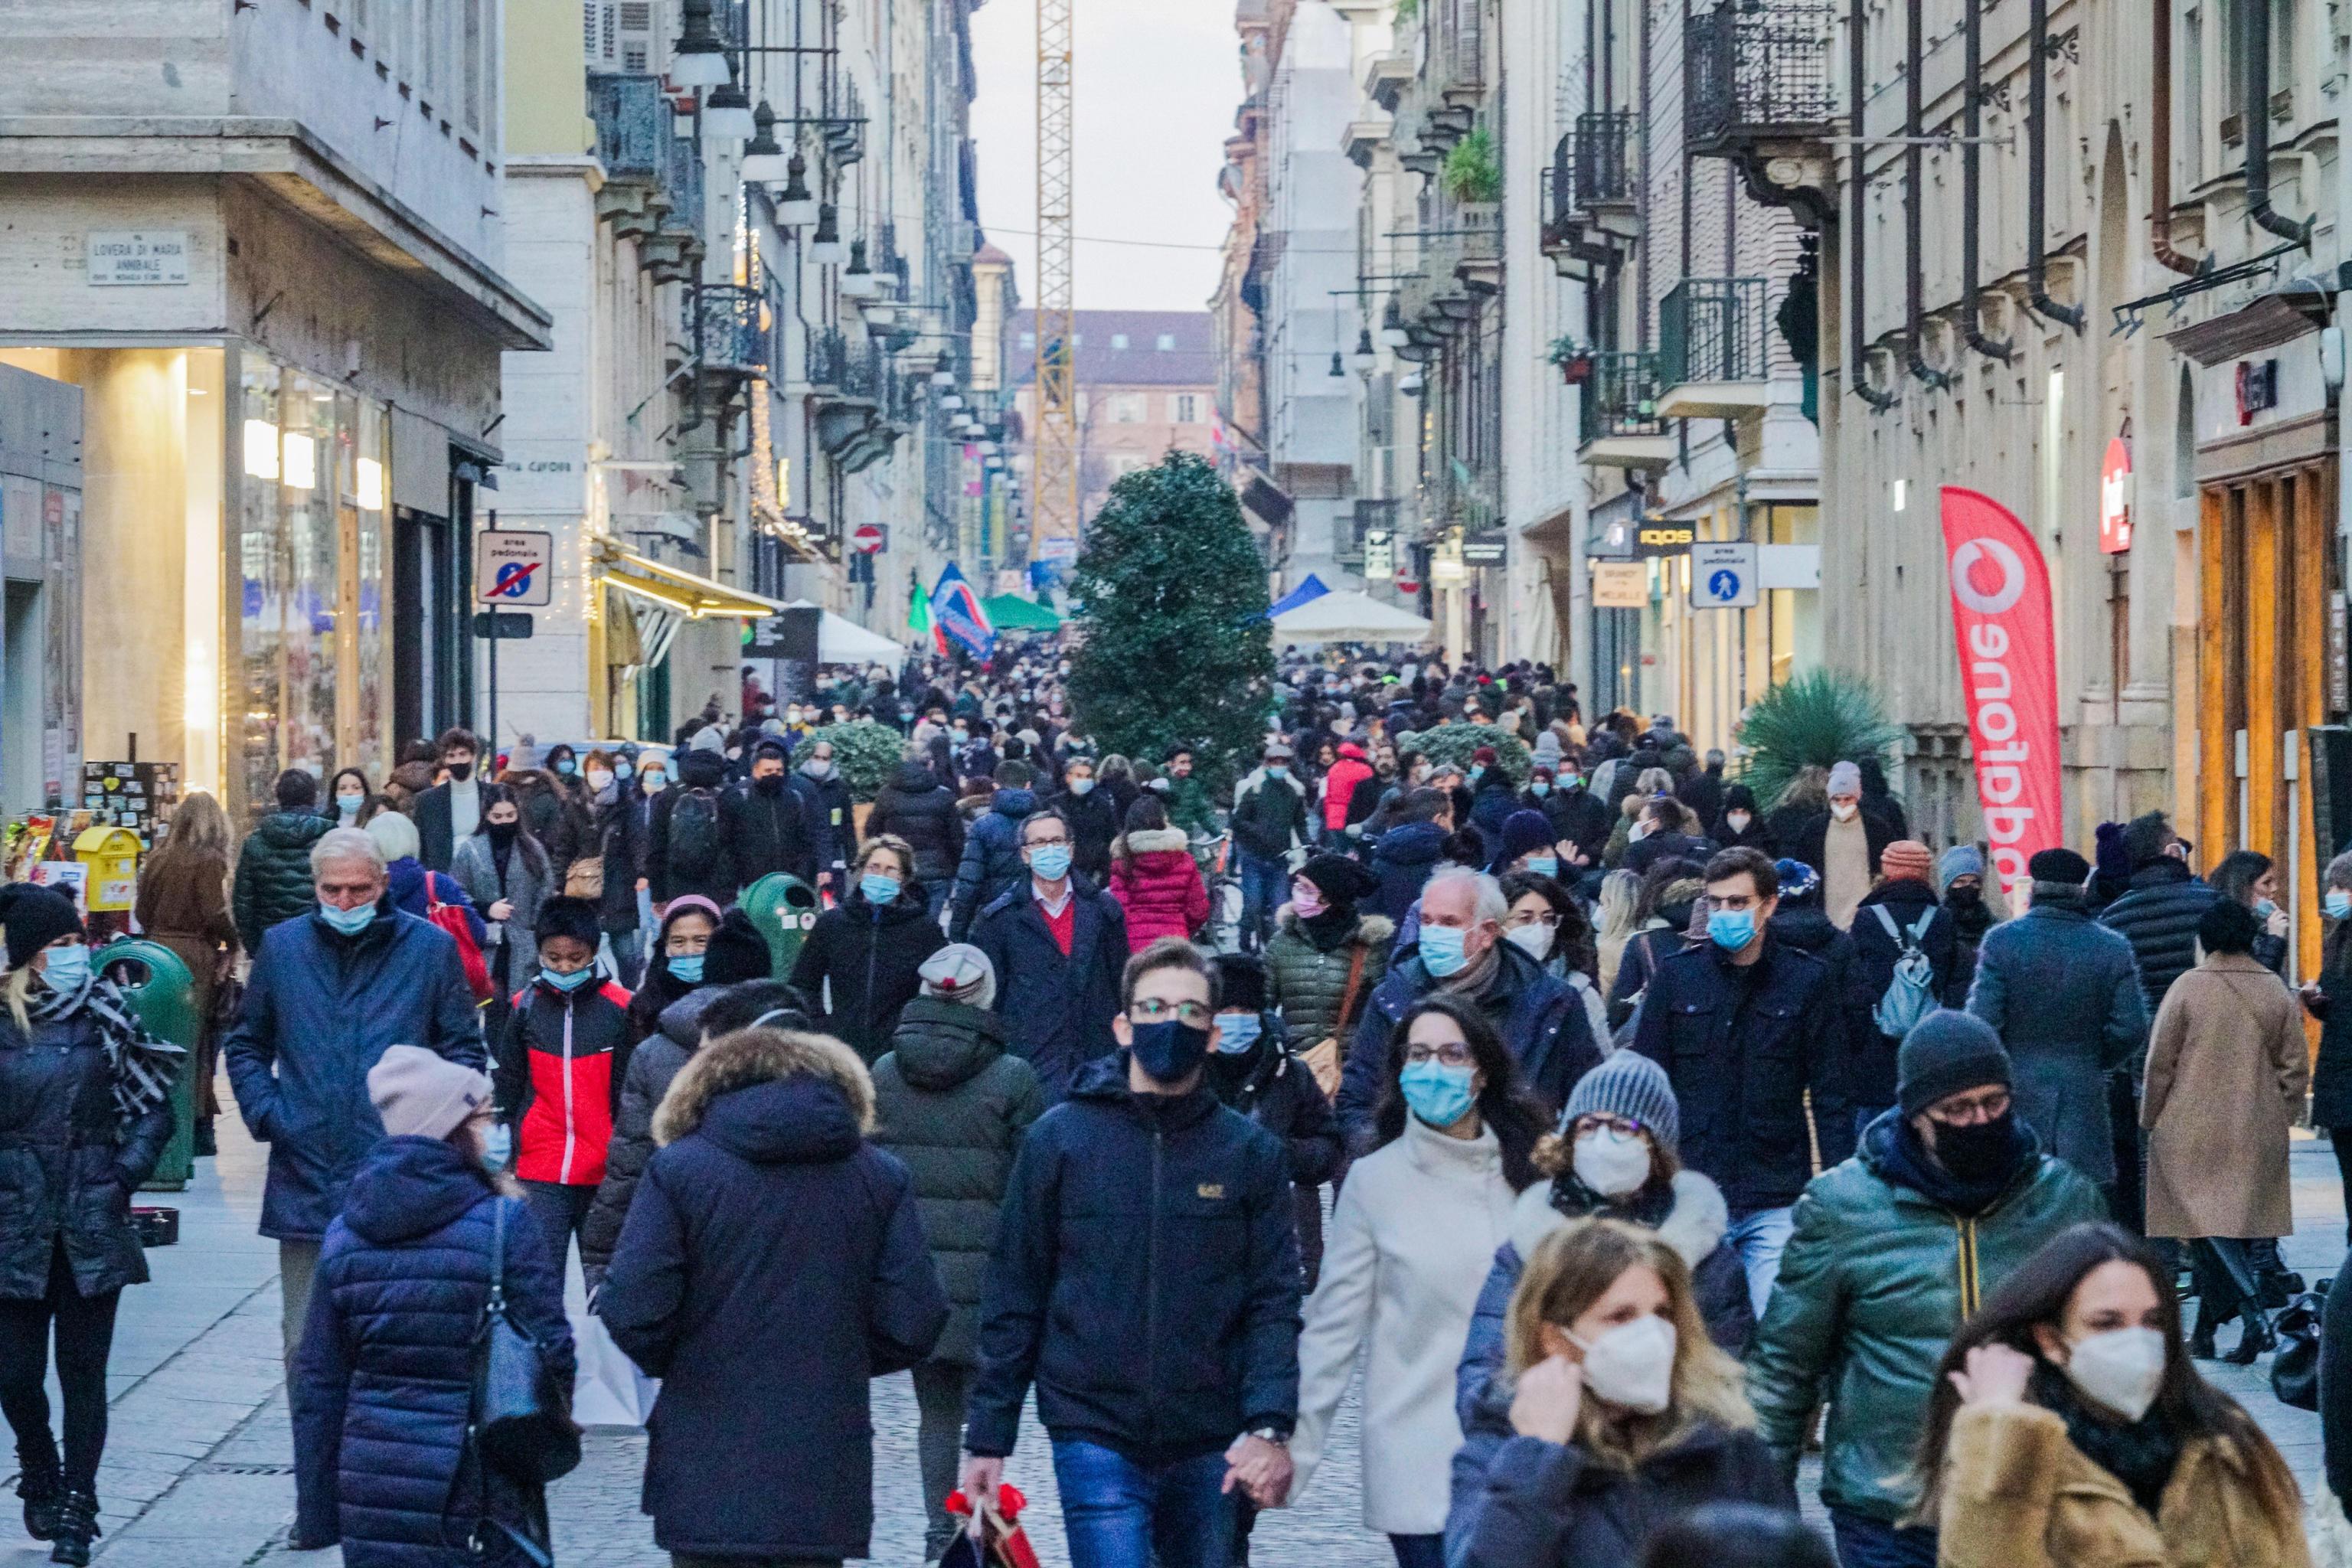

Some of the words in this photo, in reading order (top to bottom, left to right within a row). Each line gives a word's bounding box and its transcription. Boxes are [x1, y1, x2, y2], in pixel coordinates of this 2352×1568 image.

[93, 244, 130, 256] LOVERA
[137, 244, 148, 255] DI
[153, 243, 181, 255] MARIA
[116, 259, 160, 270] ANNIBALE
[1640, 530, 1693, 546] IQOS
[491, 549, 538, 557] pedonale
